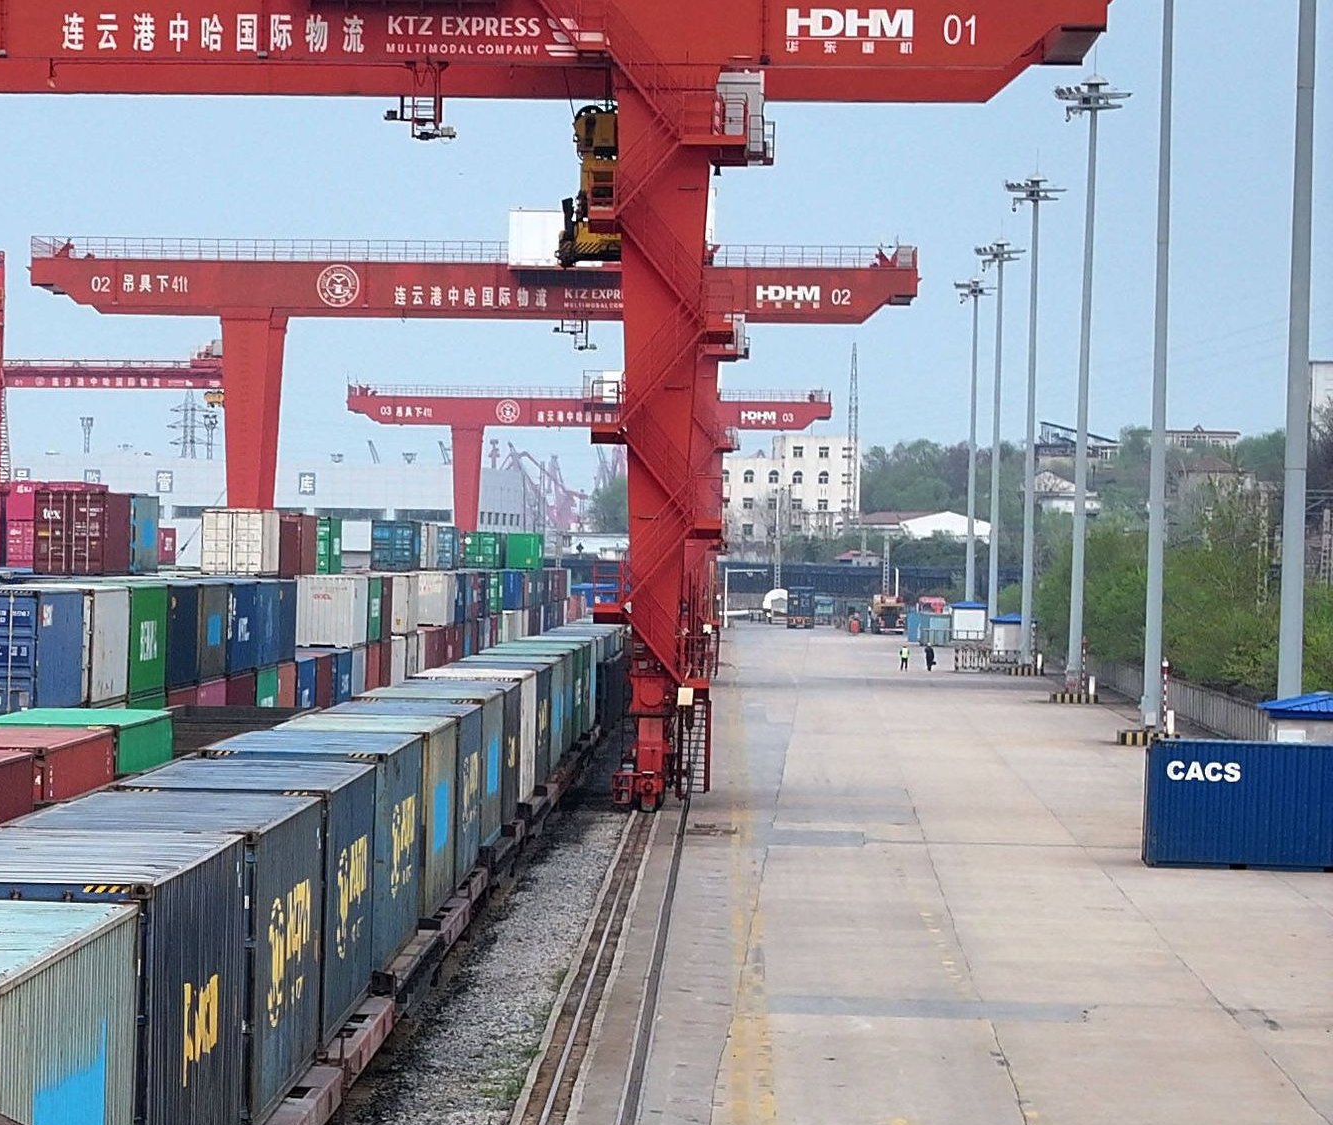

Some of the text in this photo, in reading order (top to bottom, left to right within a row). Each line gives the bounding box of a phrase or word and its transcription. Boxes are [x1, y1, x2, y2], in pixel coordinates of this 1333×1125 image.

[61, 13, 365, 53] 连云港中哈国际物流
[387, 16, 541, 37] KTZ EXPRESS
[786, 8, 914, 38] HDHM
[943, 14, 976, 45] 01
[386, 43, 540, 56] MULTIMODAL COMPANY
[92, 276, 110, 293] 02
[393, 286, 548, 309] 连云港中哈国际物流
[756, 285, 851, 305] HDHM 02
[380, 406, 392, 416] 03
[741, 411, 794, 422] HDHM 03
[43, 508, 62, 520] tex
[1166, 760, 1242, 783] CACS
